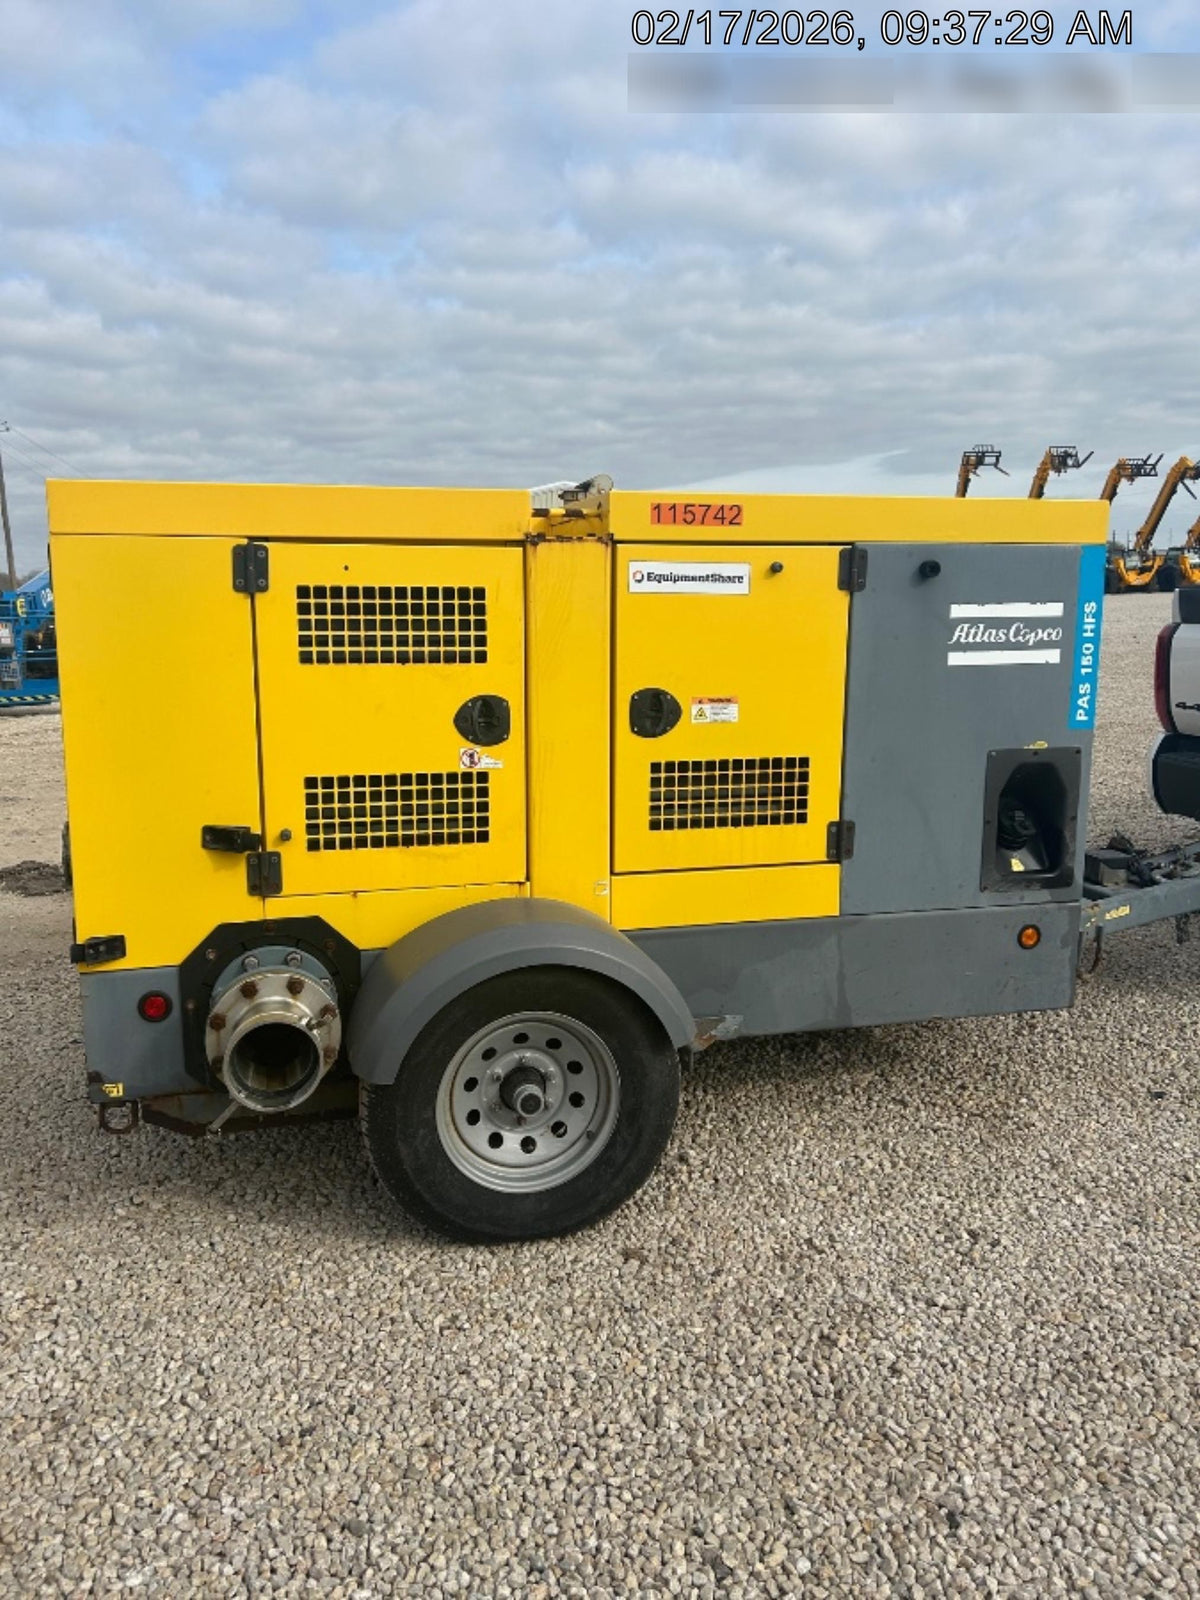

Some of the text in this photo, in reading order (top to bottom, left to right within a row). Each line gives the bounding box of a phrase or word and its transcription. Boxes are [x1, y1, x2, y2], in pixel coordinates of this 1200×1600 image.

[652, 503, 743, 526] 115742
[646, 571, 744, 584] EquipmentShare
[948, 621, 1063, 646] Atlas Copco
[1075, 601, 1097, 721] PAS 150 HFS
